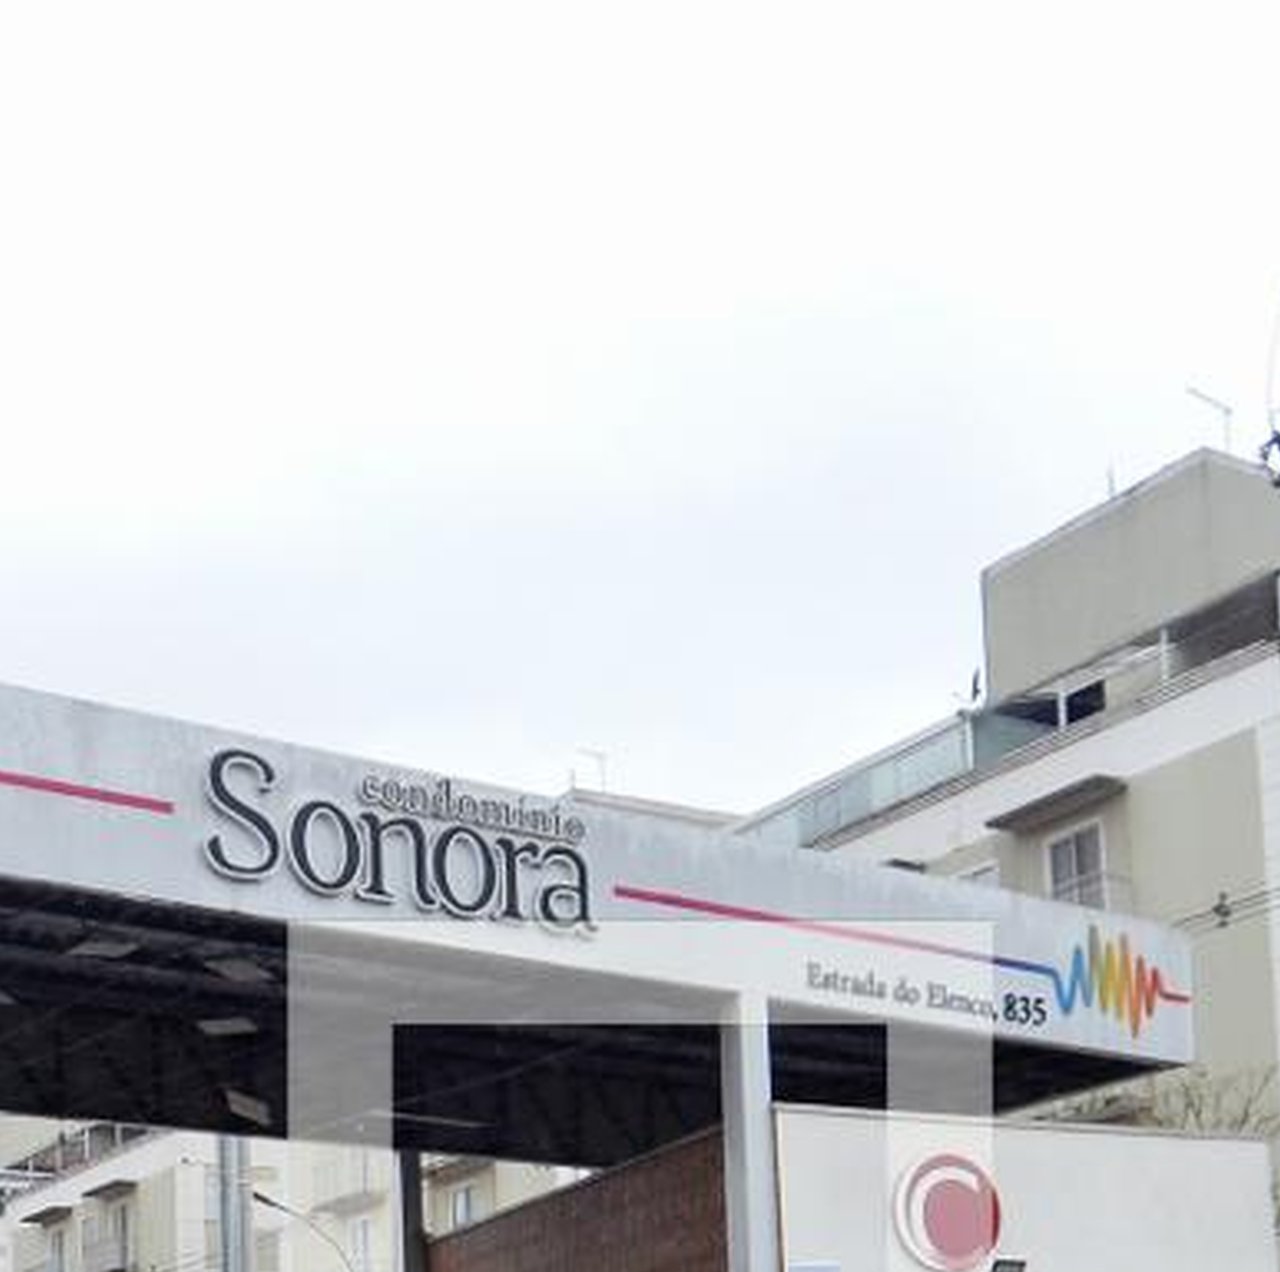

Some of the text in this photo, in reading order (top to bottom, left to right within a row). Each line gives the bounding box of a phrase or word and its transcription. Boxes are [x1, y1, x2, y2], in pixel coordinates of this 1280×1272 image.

[207, 749, 599, 932] Sonora
[806, 961, 887, 999] Estrada
[892, 978, 920, 1006] do
[1003, 993, 1047, 1026] 835
